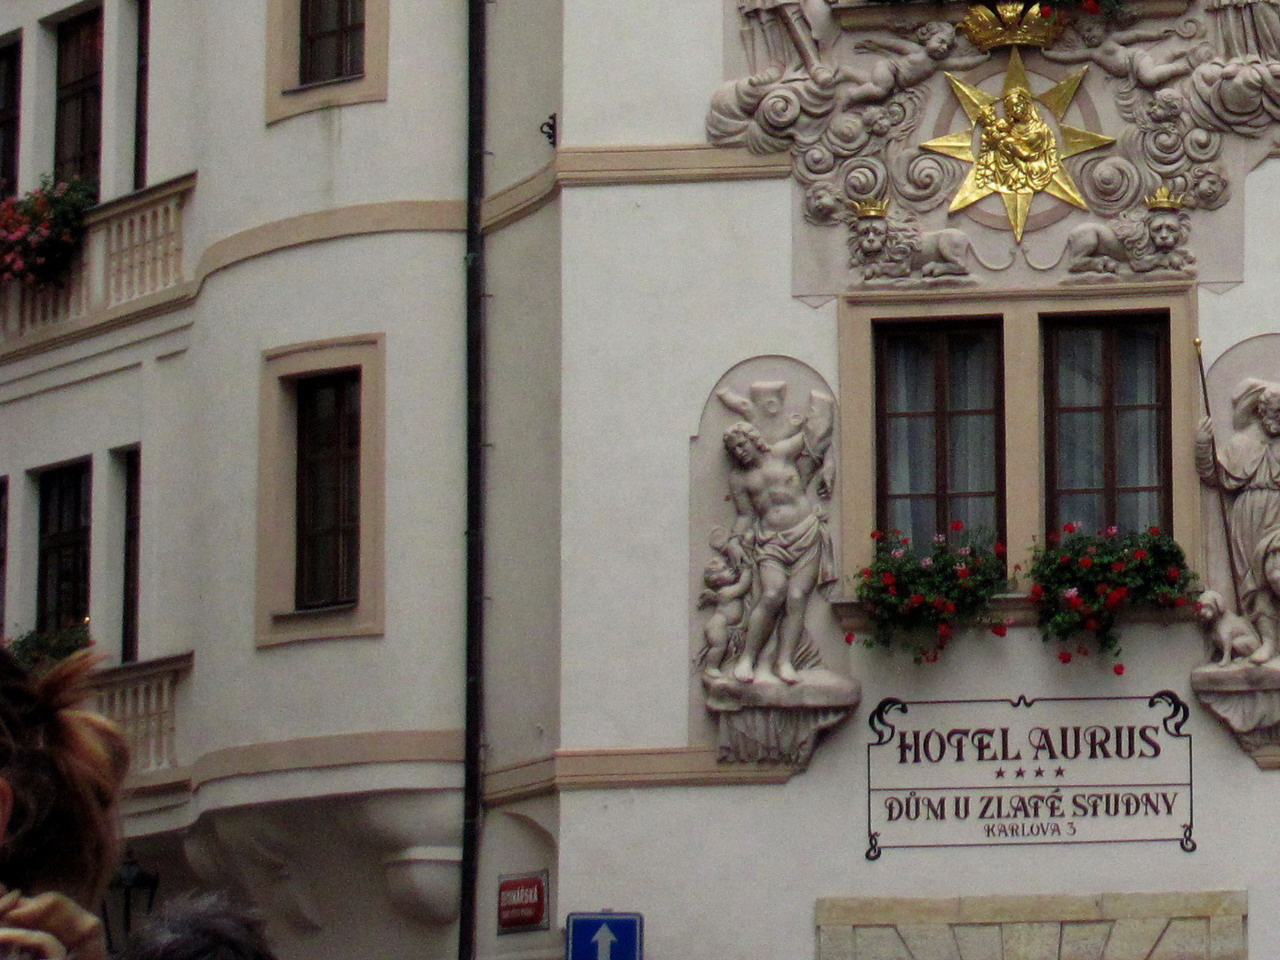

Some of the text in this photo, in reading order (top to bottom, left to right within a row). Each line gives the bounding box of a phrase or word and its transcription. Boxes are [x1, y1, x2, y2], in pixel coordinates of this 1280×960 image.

[898, 724, 1162, 765] HOTEL AURUS
[884, 787, 1178, 822] DŮM U ZLATÉ STUDNY
[984, 821, 1077, 838] KARLOVA 3
